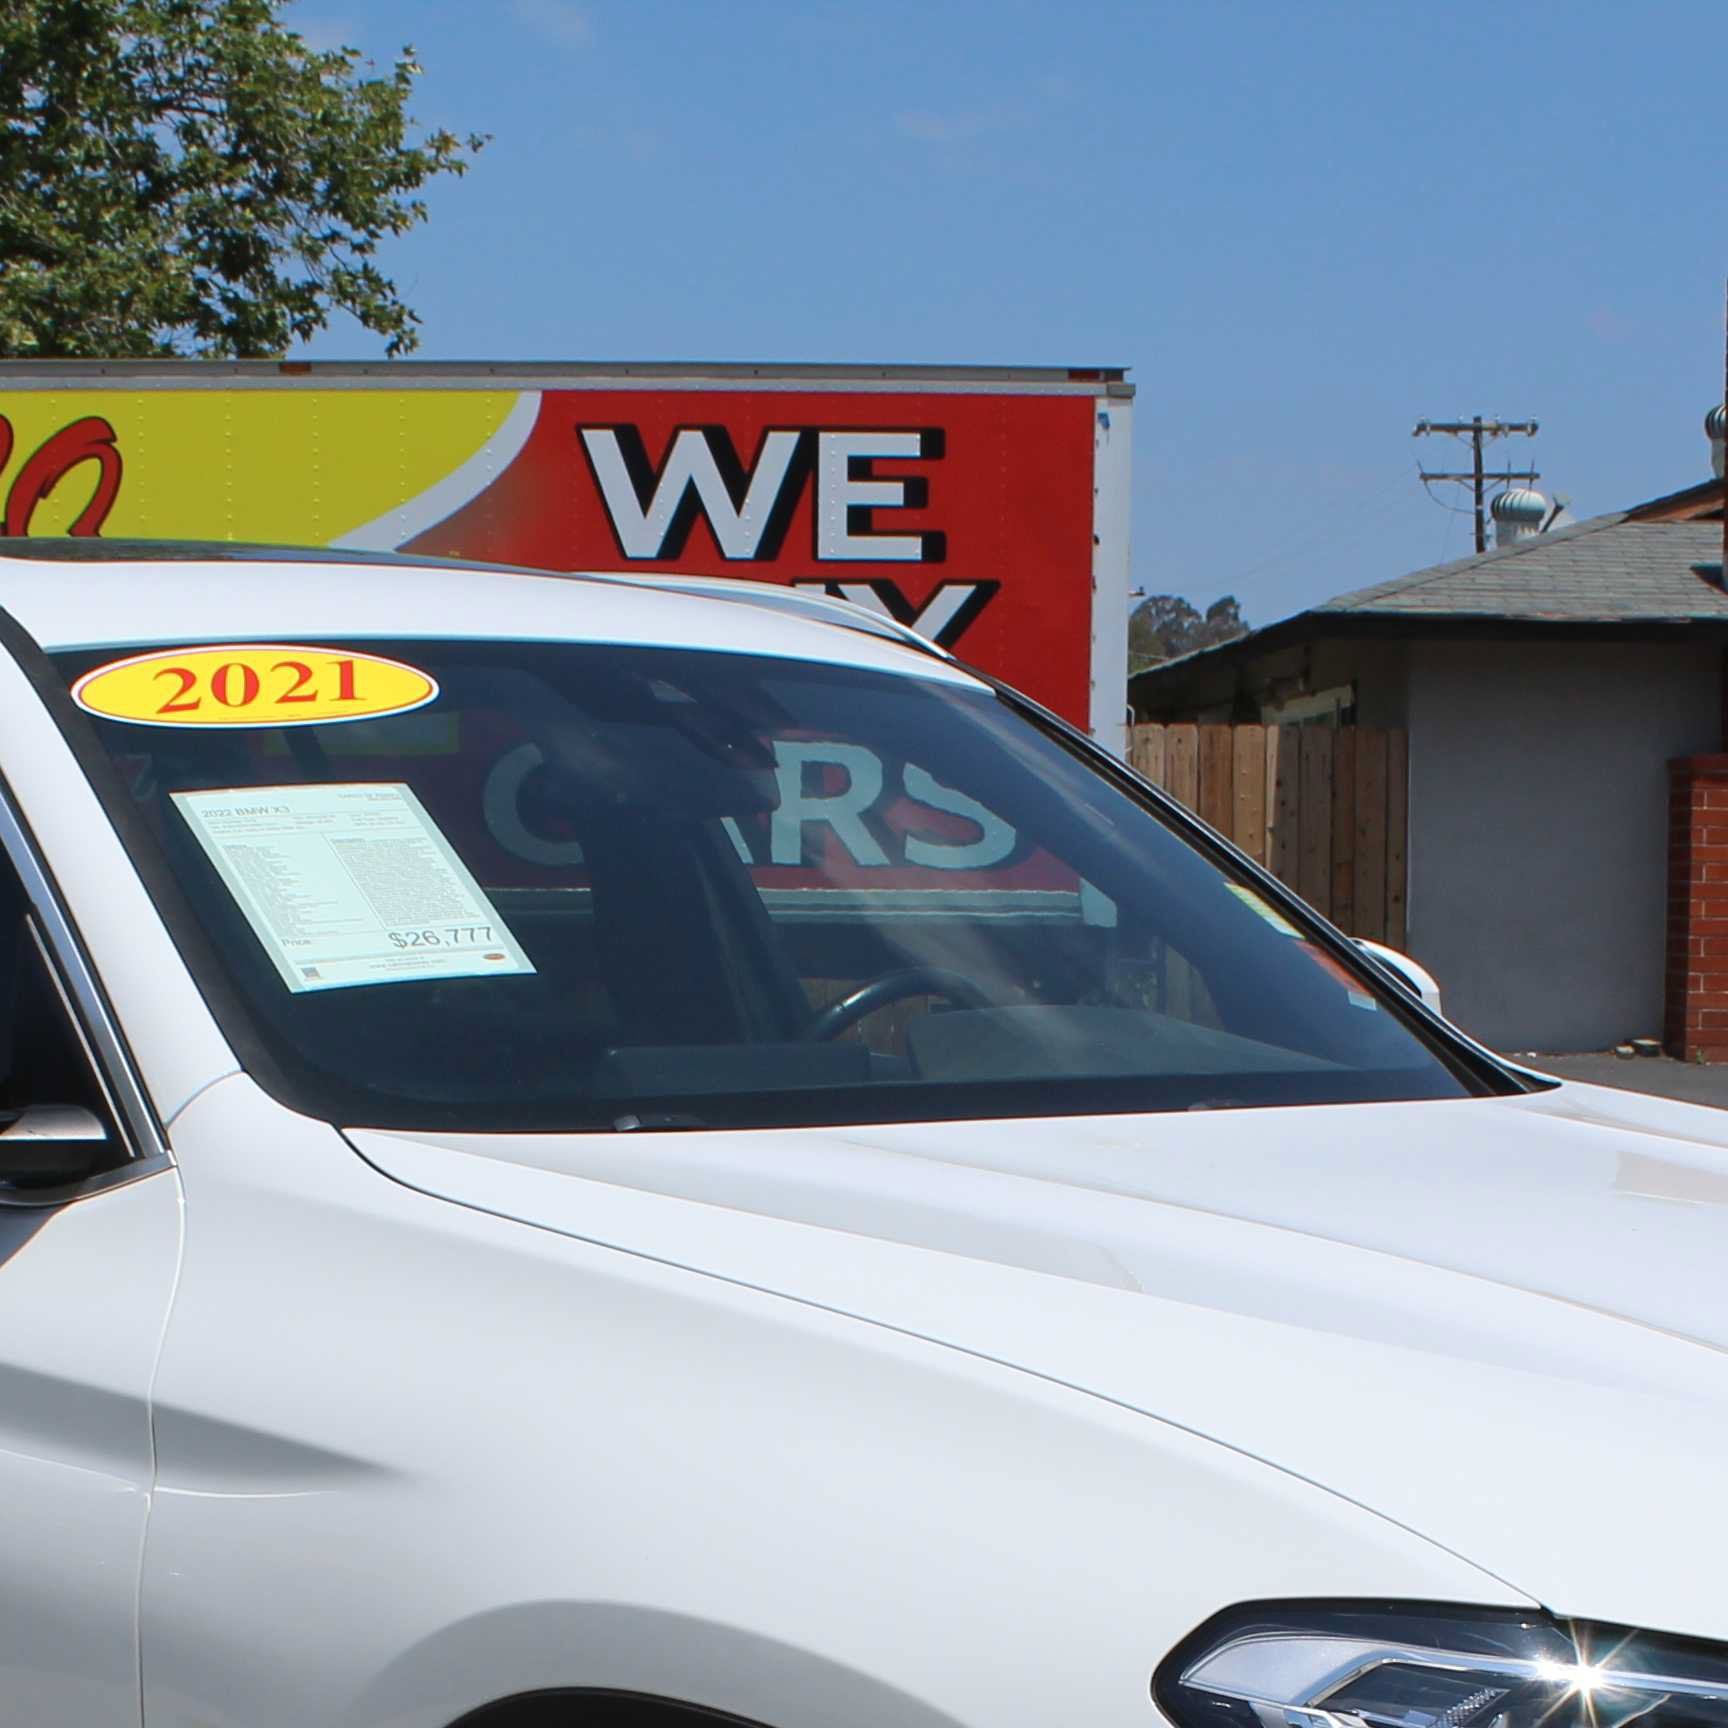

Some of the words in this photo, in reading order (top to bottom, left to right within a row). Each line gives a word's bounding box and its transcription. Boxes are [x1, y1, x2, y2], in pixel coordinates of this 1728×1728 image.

[578, 425, 945, 561] WE
[152, 659, 367, 714] 2021
[200, 809, 232, 818] 2022
[234, 806, 270, 817] BMW
[483, 740, 1017, 868] CRS
[387, 926, 493, 949] $26,777
